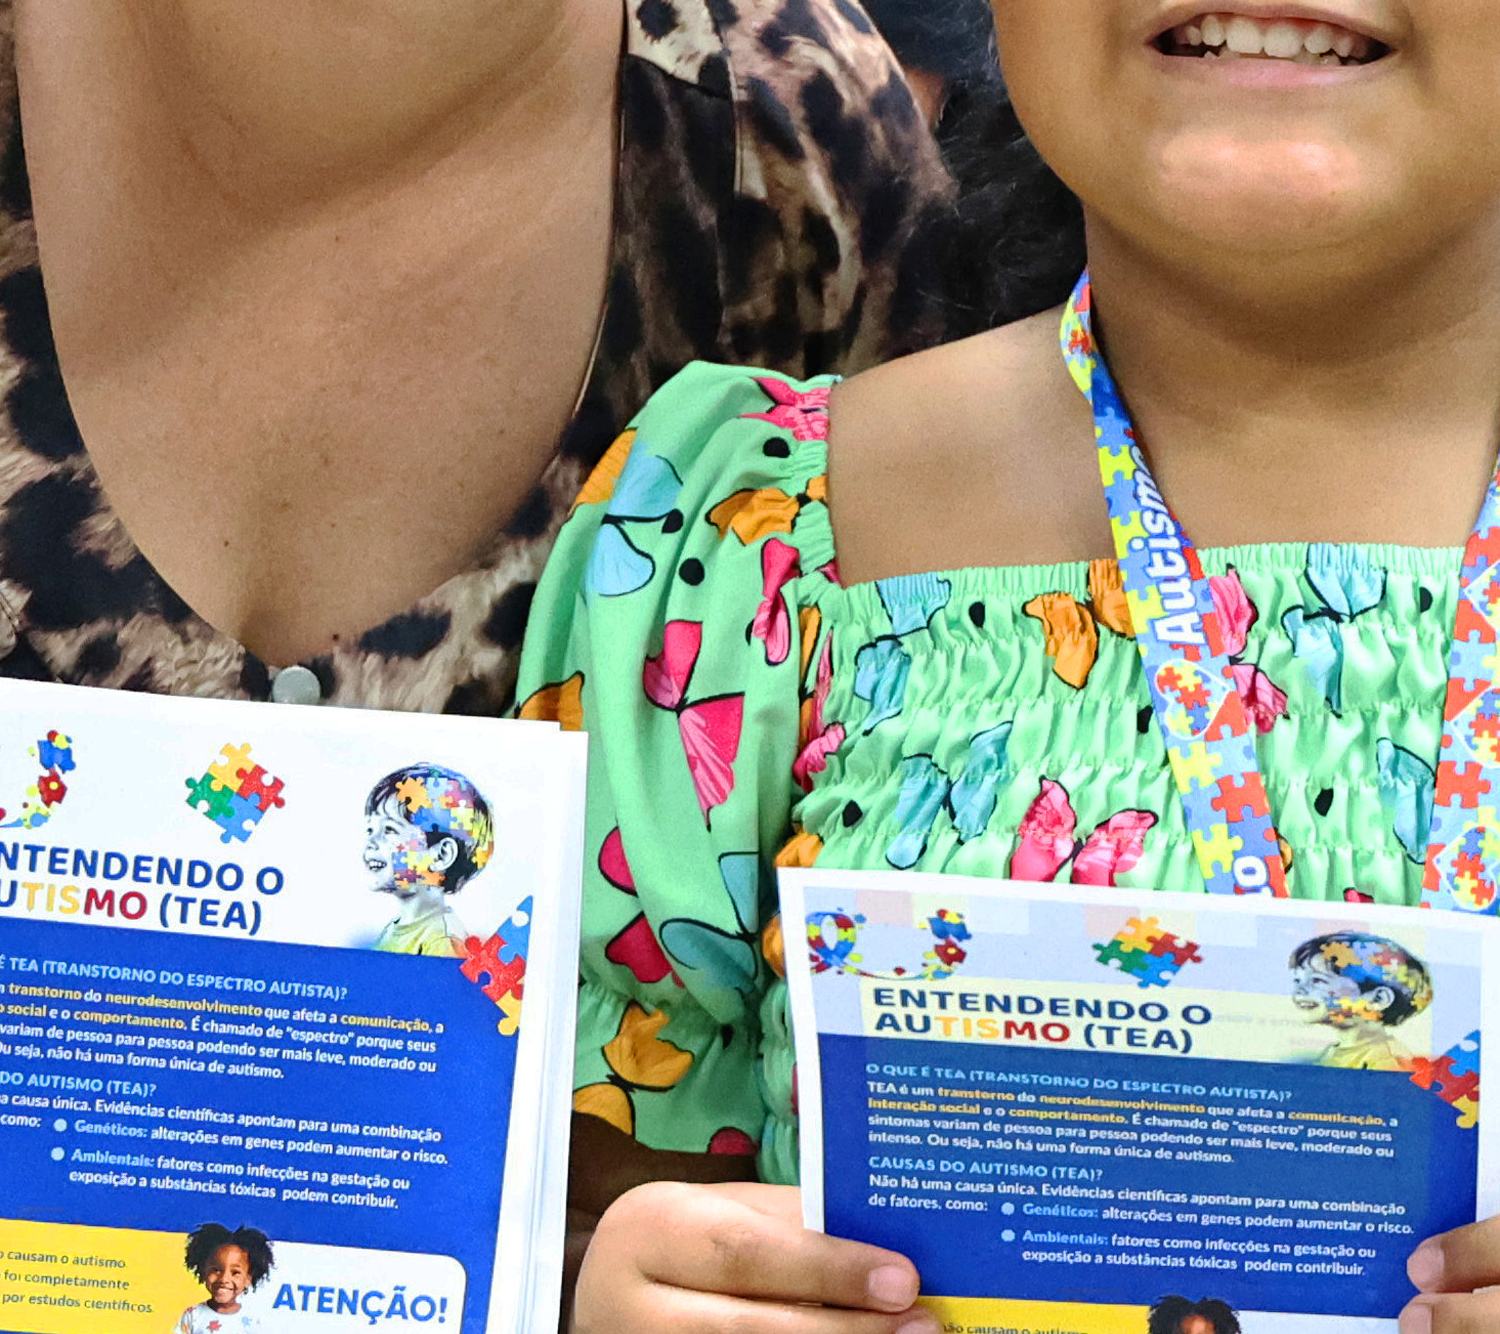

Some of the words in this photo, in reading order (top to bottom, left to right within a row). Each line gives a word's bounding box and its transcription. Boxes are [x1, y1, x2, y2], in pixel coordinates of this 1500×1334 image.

[256, 866, 284, 895] O
[159, 892, 261, 936] (TEA)
[9, 957, 38, 972] TEA
[42, 960, 156, 982] (TRANSTORNO
[159, 970, 184, 985] DO
[186, 973, 266, 992] ESPECTRO
[268, 981, 347, 1001] AUTISTA)?
[874, 988, 1168, 1022] ENTENDENDO
[1181, 1005, 1211, 1025] O
[875, 1013, 1070, 1042] AUTISMO
[1084, 1023, 1192, 1053] (TEA)
[11, 1095, 50, 1107] causa
[52, 1095, 91, 1111] única.
[95, 1098, 165, 1117] Evidências
[167, 1105, 234, 1124] científicas
[236, 1114, 296, 1129] apontam
[298, 1119, 328, 1132] para
[330, 1122, 360, 1134] uma
[362, 1124, 441, 1143] combinação
[868, 1130, 922, 1144] intenso.
[927, 1133, 949, 1146] Ou
[952, 1136, 983, 1149] seja,
[986, 1137, 1013, 1150] não
[1015, 1138, 1033, 1151] há
[1035, 1142, 1066, 1153] uma
[1069, 1142, 1111, 1155] forma
[1114, 1144, 1151, 1158] única
[1154, 1147, 1172, 1159] de
[1175, 1150, 1234, 1162] autismo.
[869, 1156, 935, 1171] CAUSAS
[939, 1160, 965, 1172] DO
[969, 1161, 1047, 1176] AUTISMO
[1051, 1166, 1103, 1181] (TEA)?
[7, 1251, 57, 1263] causam
[60, 1255, 69, 1264] o
[24, 1274, 129, 1290] completamente
[2, 1294, 25, 1304] por
[28, 1294, 80, 1307] estudos
[272, 1283, 447, 1325] ATENÇÃO!
